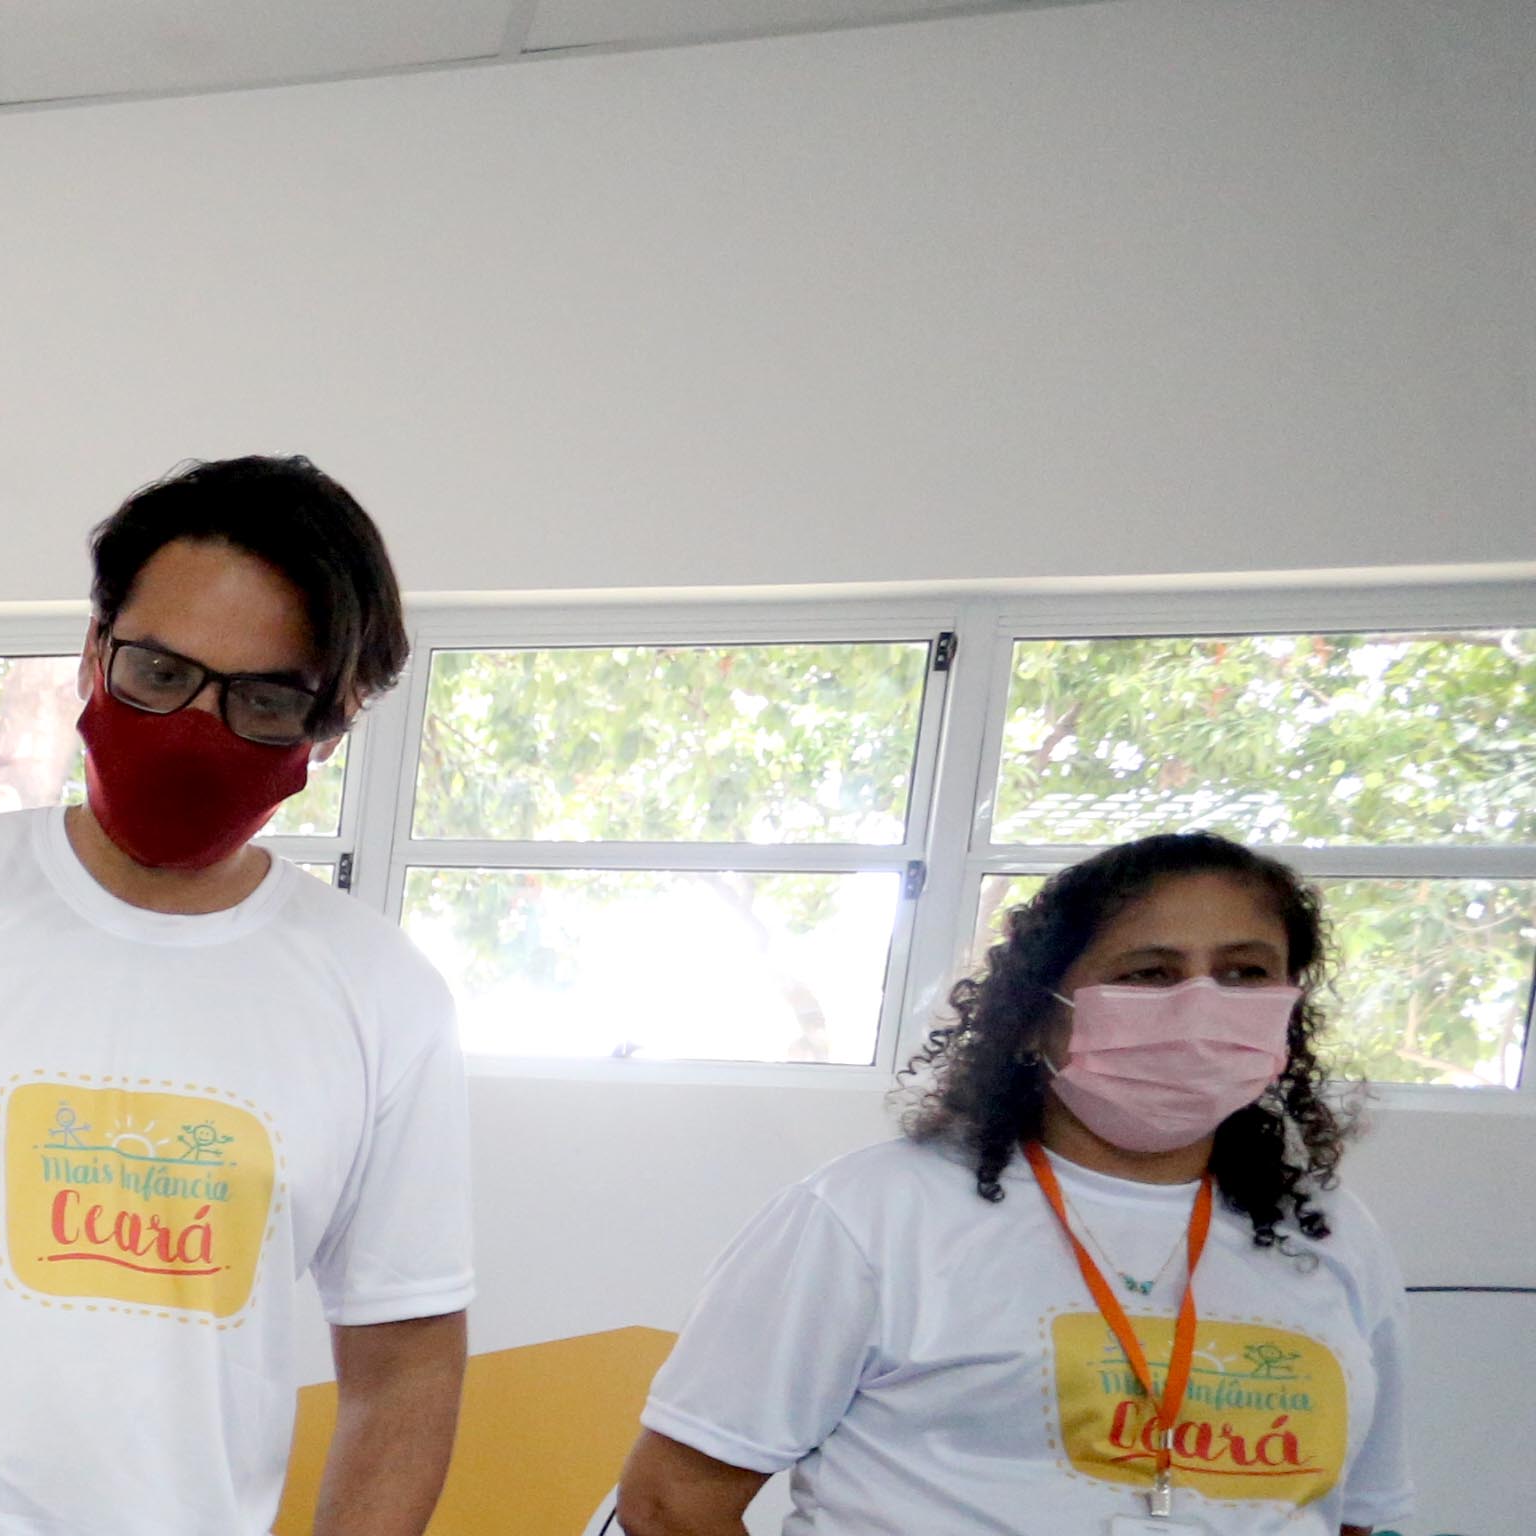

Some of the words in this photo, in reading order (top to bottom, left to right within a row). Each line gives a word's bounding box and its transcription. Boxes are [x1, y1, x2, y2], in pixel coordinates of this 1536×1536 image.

[41, 1155, 113, 1184] Mais
[119, 1164, 232, 1202] Infância
[50, 1189, 213, 1264] Ceará
